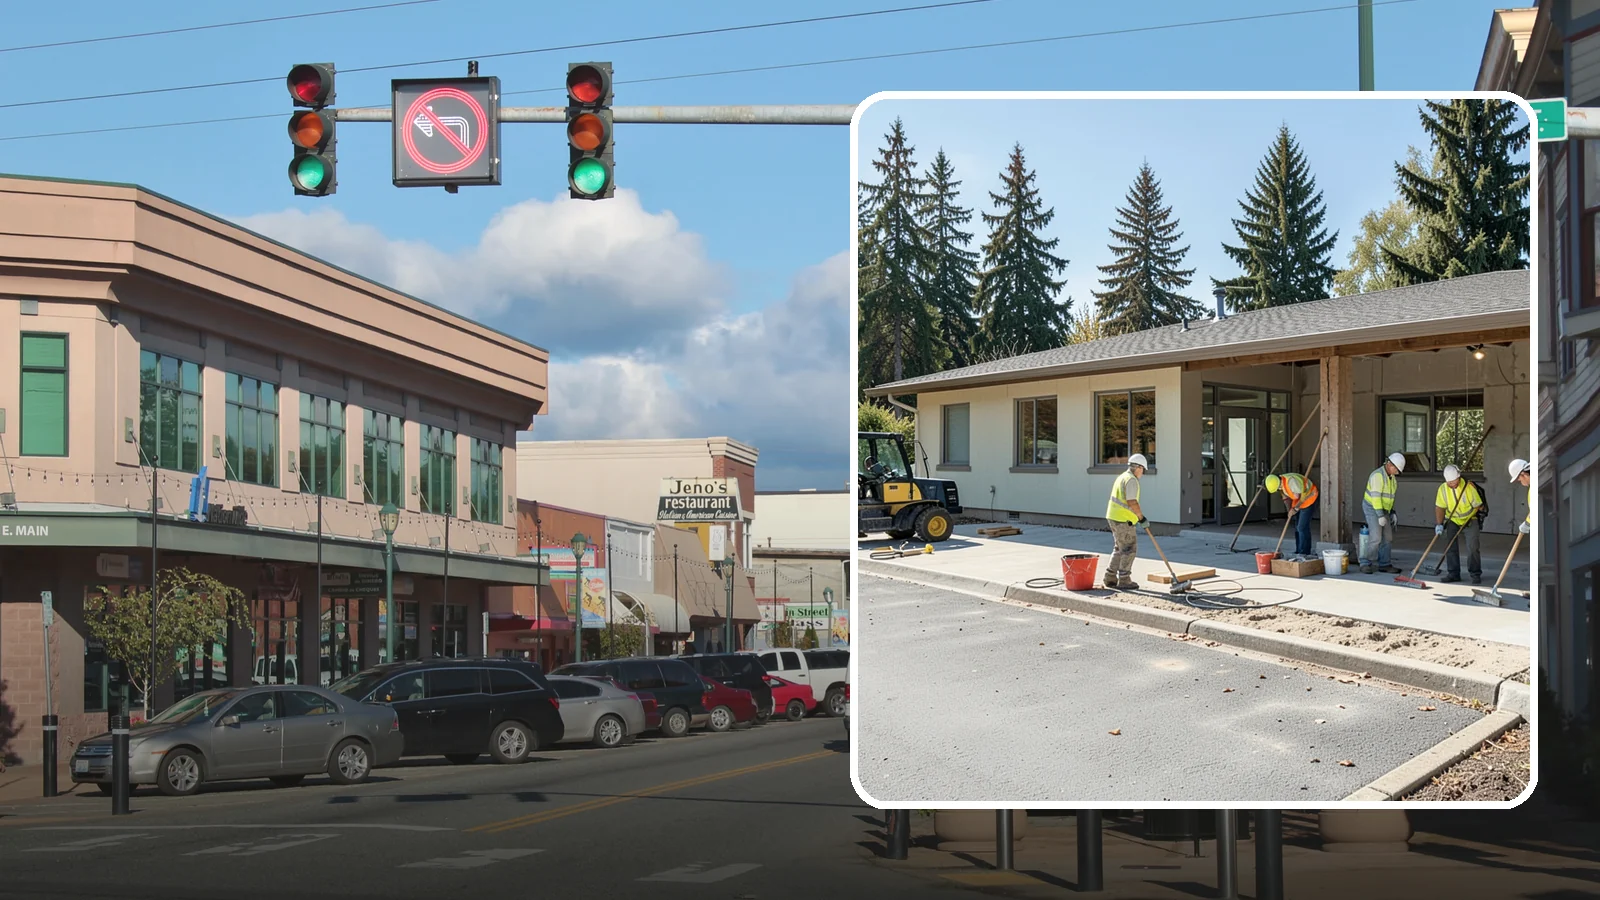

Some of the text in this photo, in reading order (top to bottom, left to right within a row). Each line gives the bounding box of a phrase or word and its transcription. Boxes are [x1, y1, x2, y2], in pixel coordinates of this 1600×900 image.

[669, 480, 728, 494] Jeno's
[665, 496, 731, 509] restaurant
[686, 509, 714, 519] American
[715, 509, 737, 519] Cuisine
[2, 525, 49, 536] E. MAIN
[797, 607, 828, 617] Street
